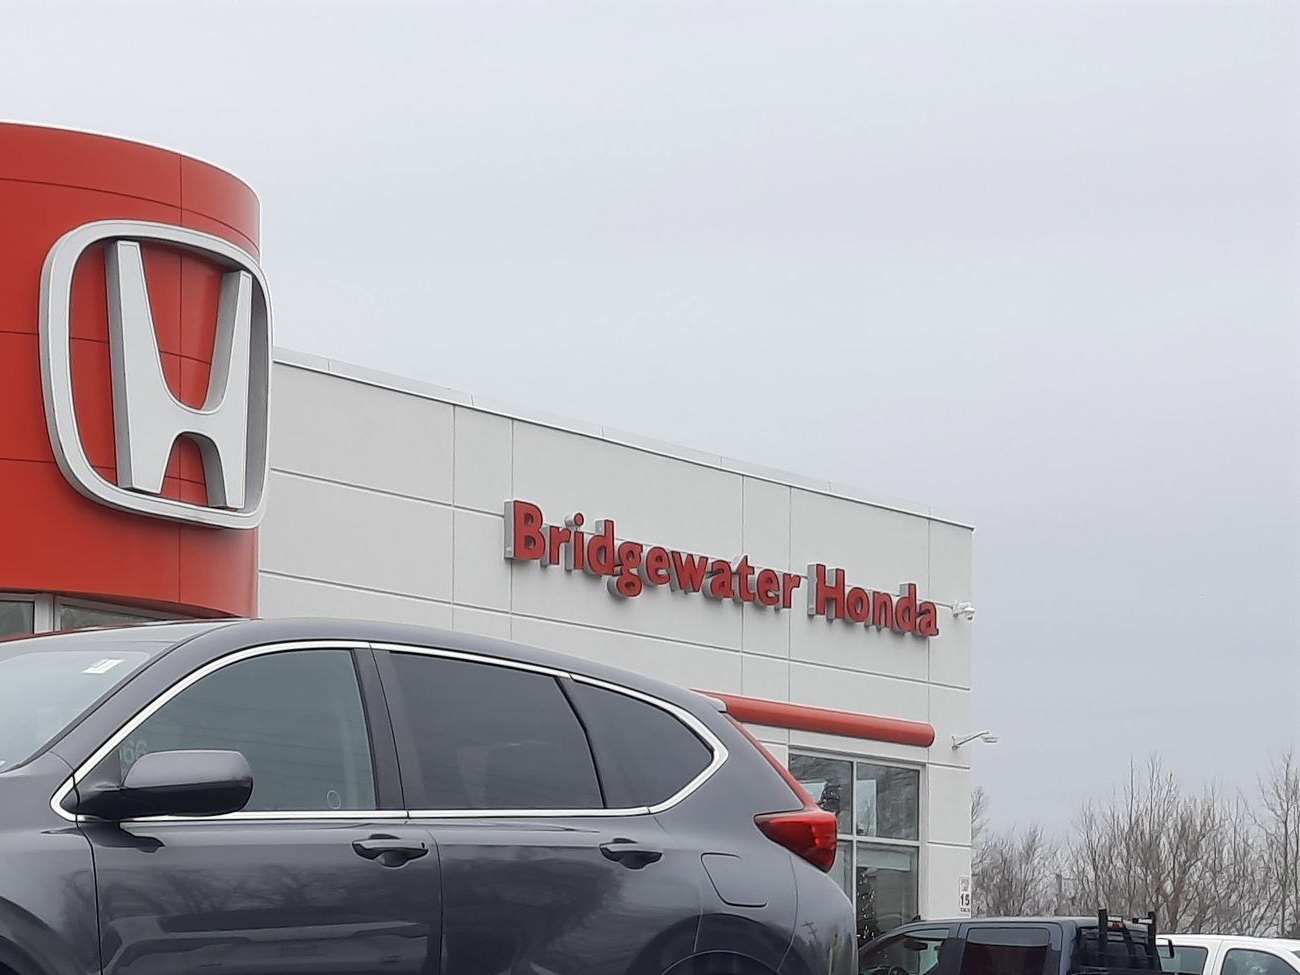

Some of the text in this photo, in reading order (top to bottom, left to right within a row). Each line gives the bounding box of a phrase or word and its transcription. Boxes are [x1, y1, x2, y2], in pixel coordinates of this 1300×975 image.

[504, 499, 940, 638] Bridgewater Honda
[960, 893, 970, 906] 15
